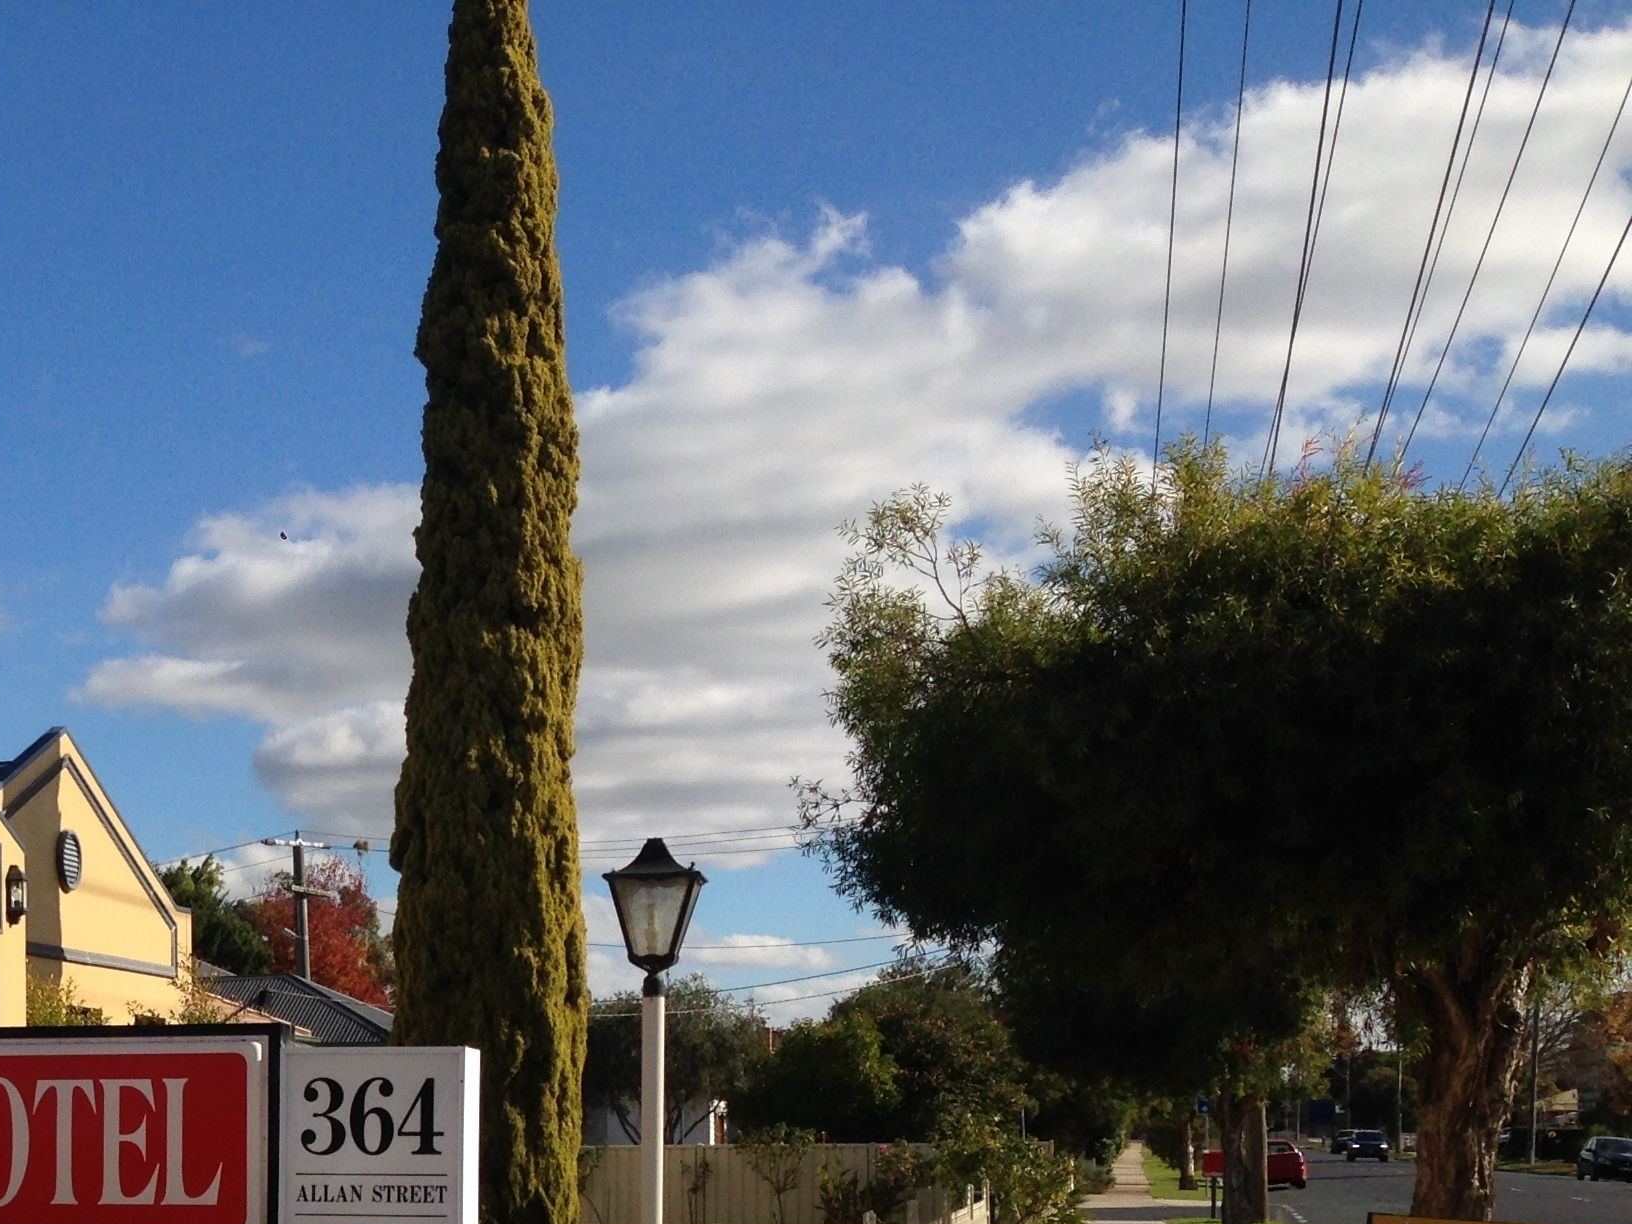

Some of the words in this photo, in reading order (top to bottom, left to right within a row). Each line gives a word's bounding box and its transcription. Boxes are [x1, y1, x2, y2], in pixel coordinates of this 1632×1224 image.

[301, 1076, 444, 1156] 364
[296, 1185, 363, 1204] ALLAN
[372, 1185, 448, 1204] STREET
